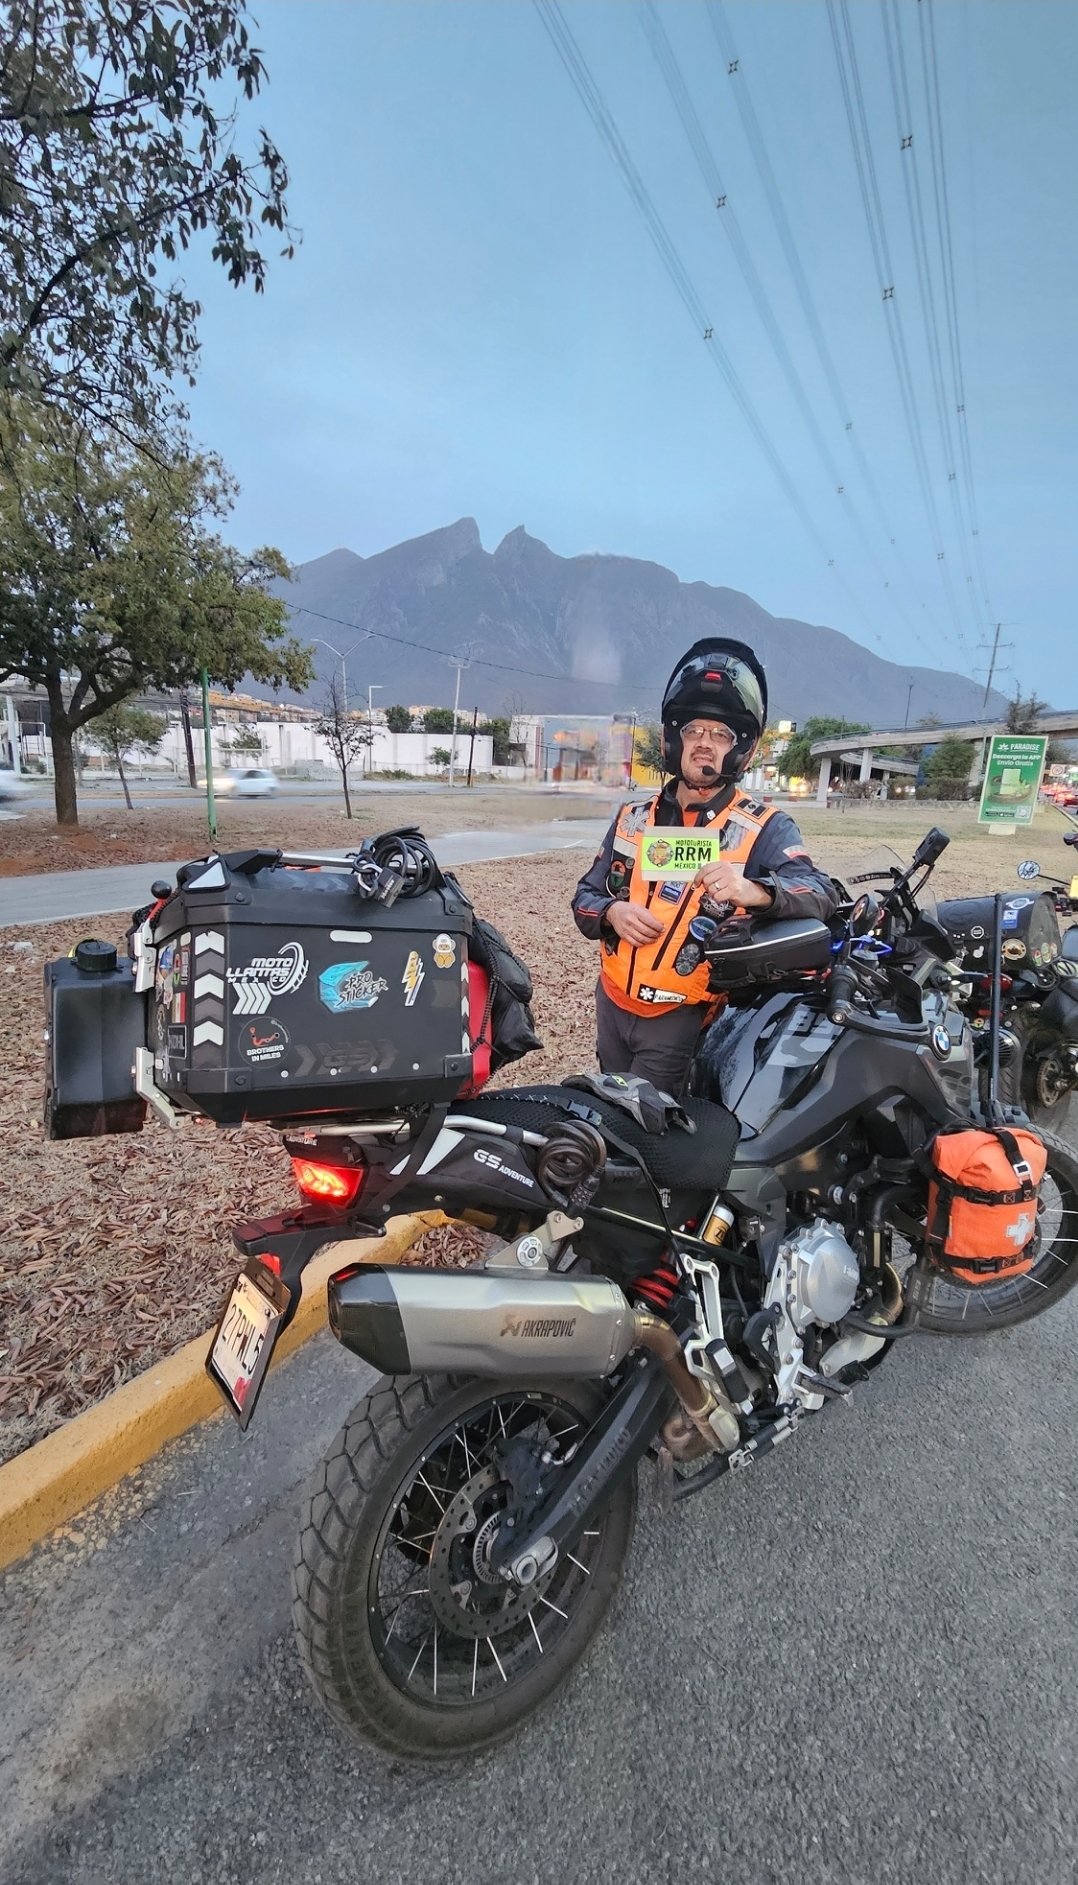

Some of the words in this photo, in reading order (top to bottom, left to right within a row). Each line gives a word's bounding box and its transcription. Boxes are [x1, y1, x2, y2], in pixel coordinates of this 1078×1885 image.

[1010, 743, 1040, 751] PARADISE
[675, 839, 712, 847] MOTOTURISTA
[674, 846, 712, 862] RRM
[251, 957, 294, 968] MOTO
[226, 967, 291, 977] LLANTAS
[346, 971, 374, 989] PRO
[335, 977, 389, 1008] STICKER
[246, 1045, 284, 1056] BROTHERS
[260, 1052, 281, 1061] MILES
[473, 1149, 502, 1169] GS
[498, 1165, 534, 1188] ADVENTURE
